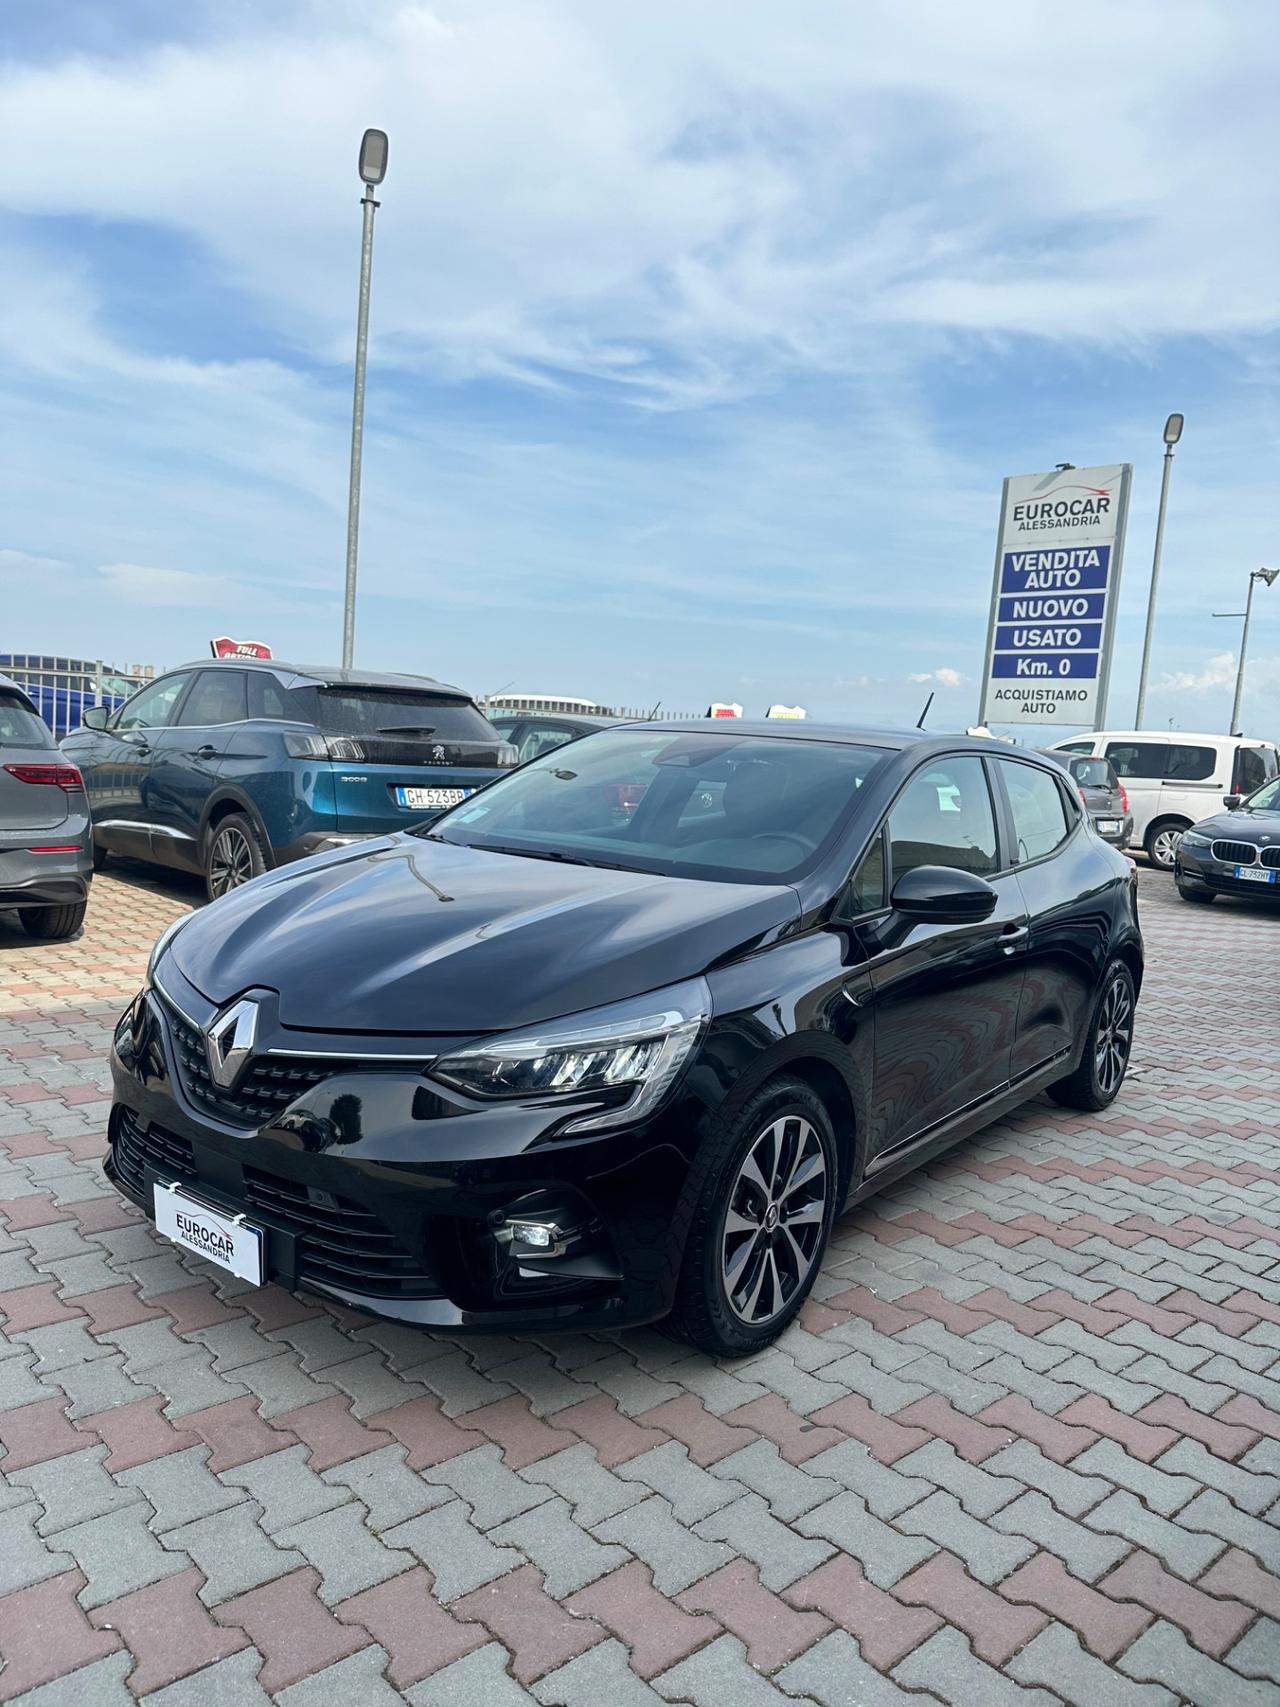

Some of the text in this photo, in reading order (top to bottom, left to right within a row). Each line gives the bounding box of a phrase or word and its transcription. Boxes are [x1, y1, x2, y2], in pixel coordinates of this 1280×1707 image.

[1013, 497, 1110, 521] EUROCAR
[1018, 515, 1101, 531] ALESSANDRIA
[1011, 550, 1100, 571] VENDITA
[1024, 570, 1081, 589] AUTO
[1013, 598, 1088, 618] NUOVO
[1013, 628, 1082, 647] USATO
[236, 645, 257, 656] FULL
[1017, 658, 1071, 676] Km. 0
[994, 689, 1088, 702] ACQUISTIAMO
[1021, 702, 1056, 714] AUTO
[176, 1213, 234, 1257] EUROCAR
[181, 1231, 230, 1264] ALESSANDRIA
